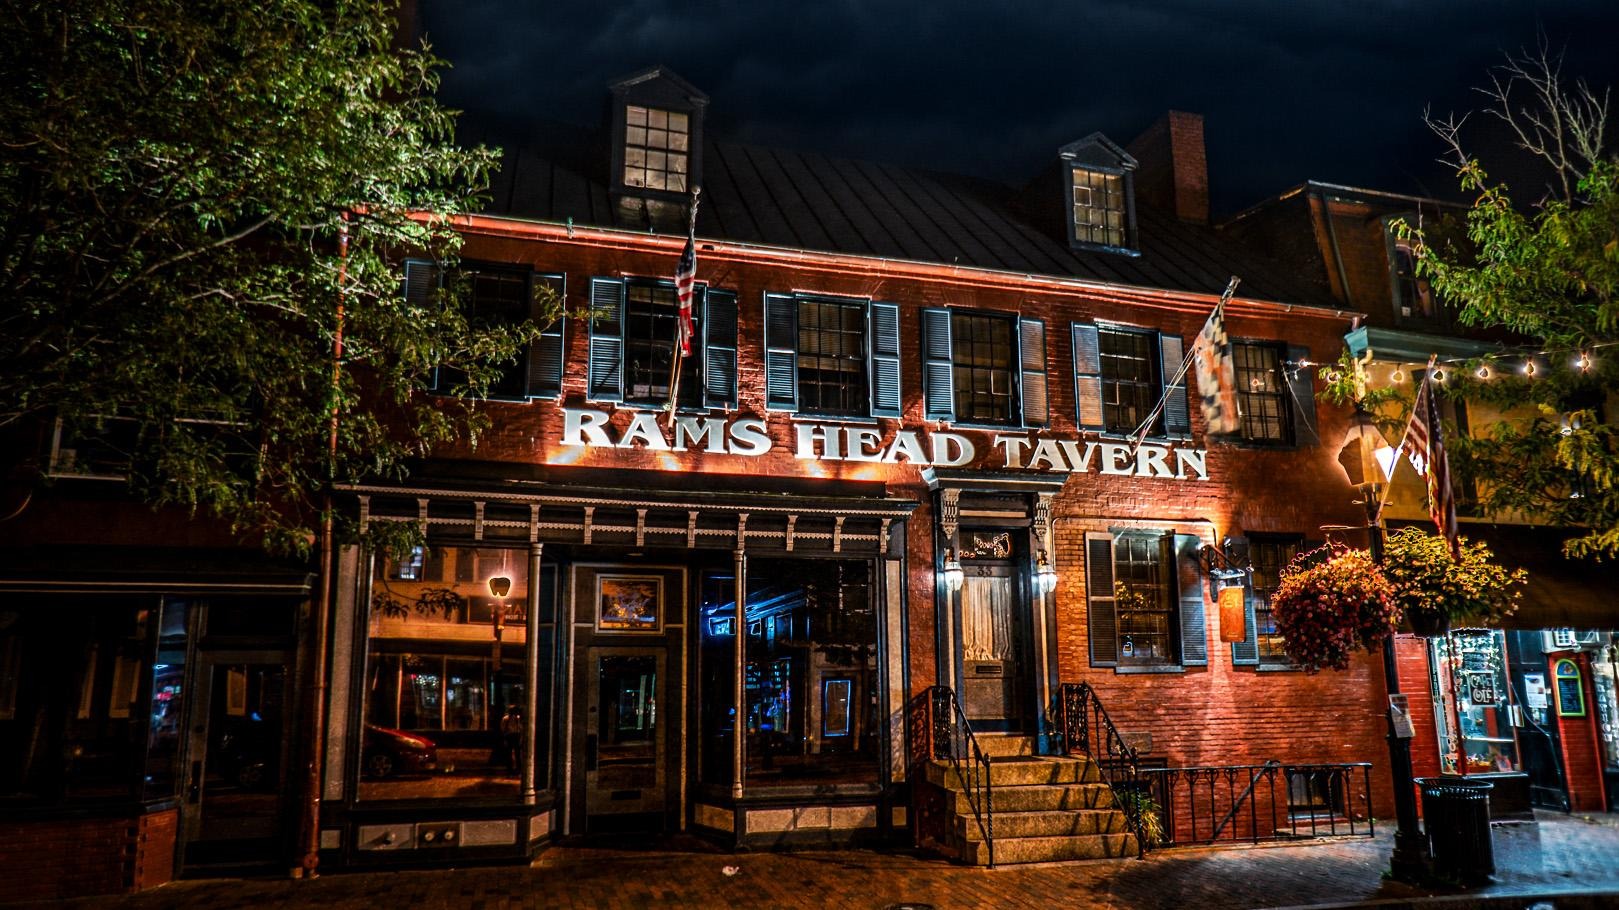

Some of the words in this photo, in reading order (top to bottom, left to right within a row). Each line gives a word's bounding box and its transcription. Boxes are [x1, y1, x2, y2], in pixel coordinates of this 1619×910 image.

[560, 408, 772, 456] RAMS
[794, 422, 976, 467] HEAD
[994, 434, 1210, 481] TAVERN
[977, 565, 993, 577] 33
